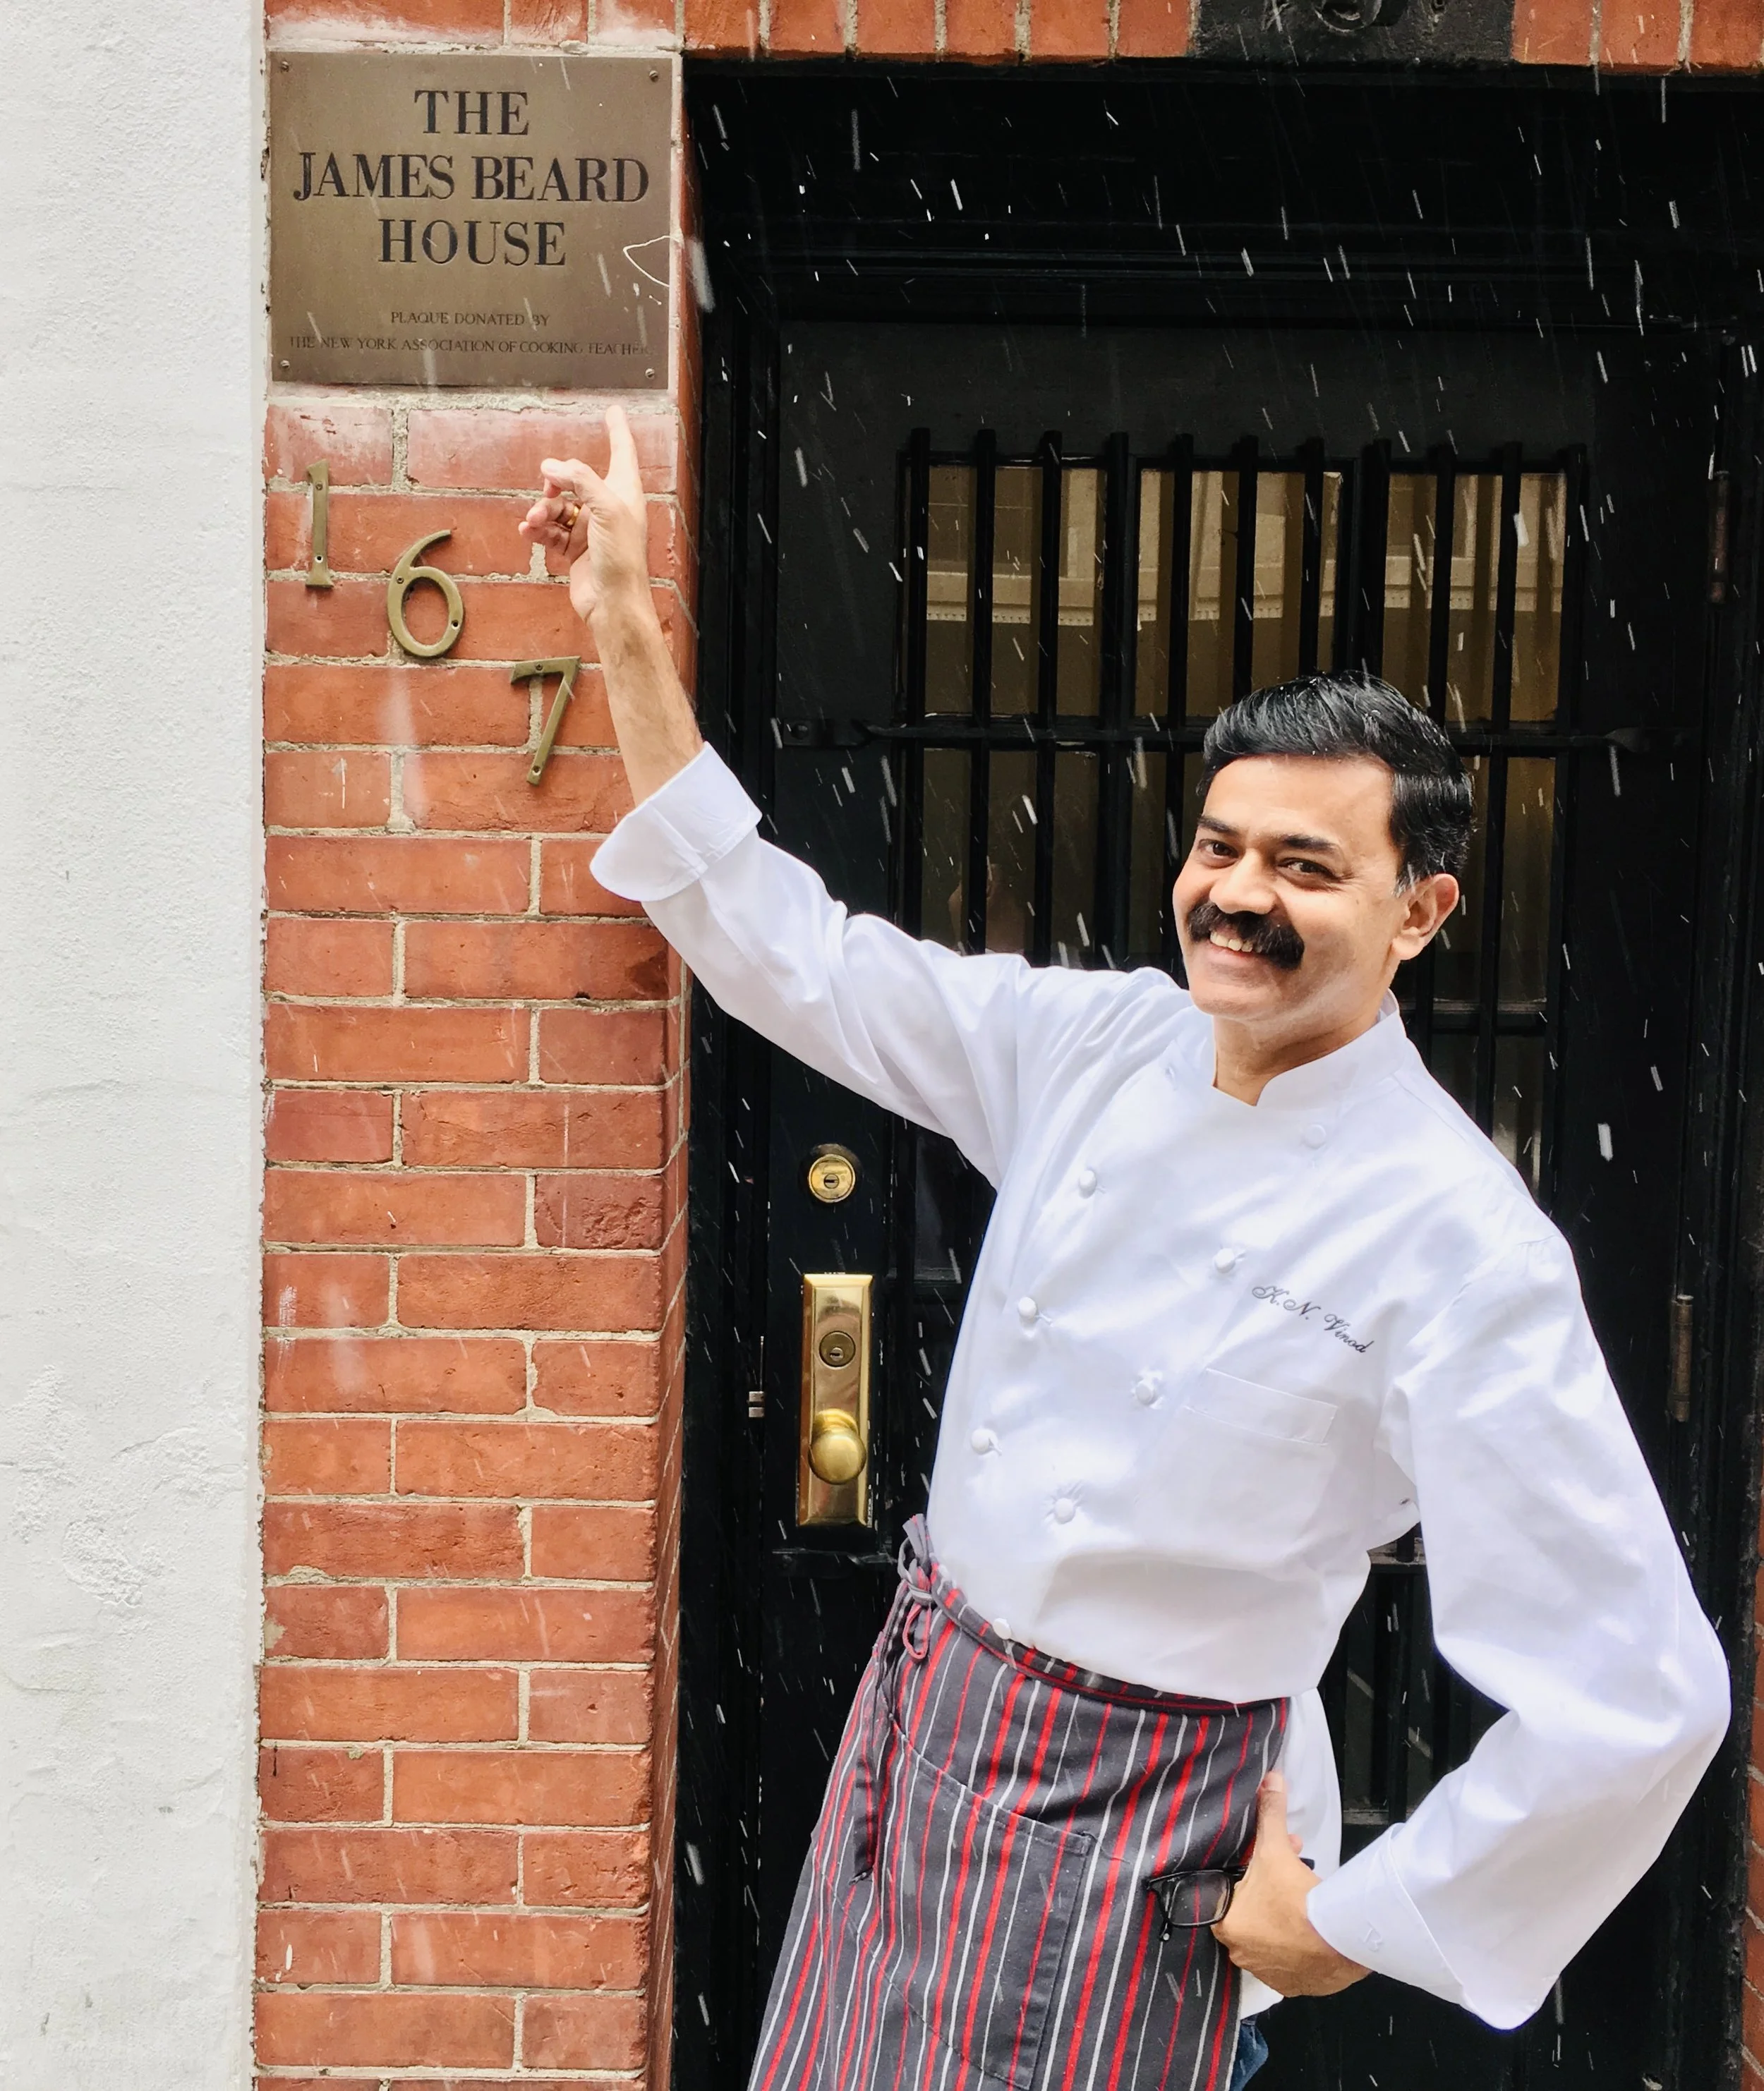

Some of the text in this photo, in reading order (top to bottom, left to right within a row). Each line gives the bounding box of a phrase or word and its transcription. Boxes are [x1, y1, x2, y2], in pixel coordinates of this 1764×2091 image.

[414, 90, 529, 136] THE
[294, 152, 649, 202] JAMES BEARD
[377, 219, 566, 266] HOUSE
[391, 311, 449, 325] PLAQUE
[454, 313, 525, 327] DONATED
[320, 337, 351, 349] NEW
[357, 338, 397, 350] YORK
[401, 339, 494, 352] ASSOCIATION
[498, 341, 517, 353] OF
[519, 341, 583, 353] COOKING
[1324, 1314, 1375, 1353] Vinod
